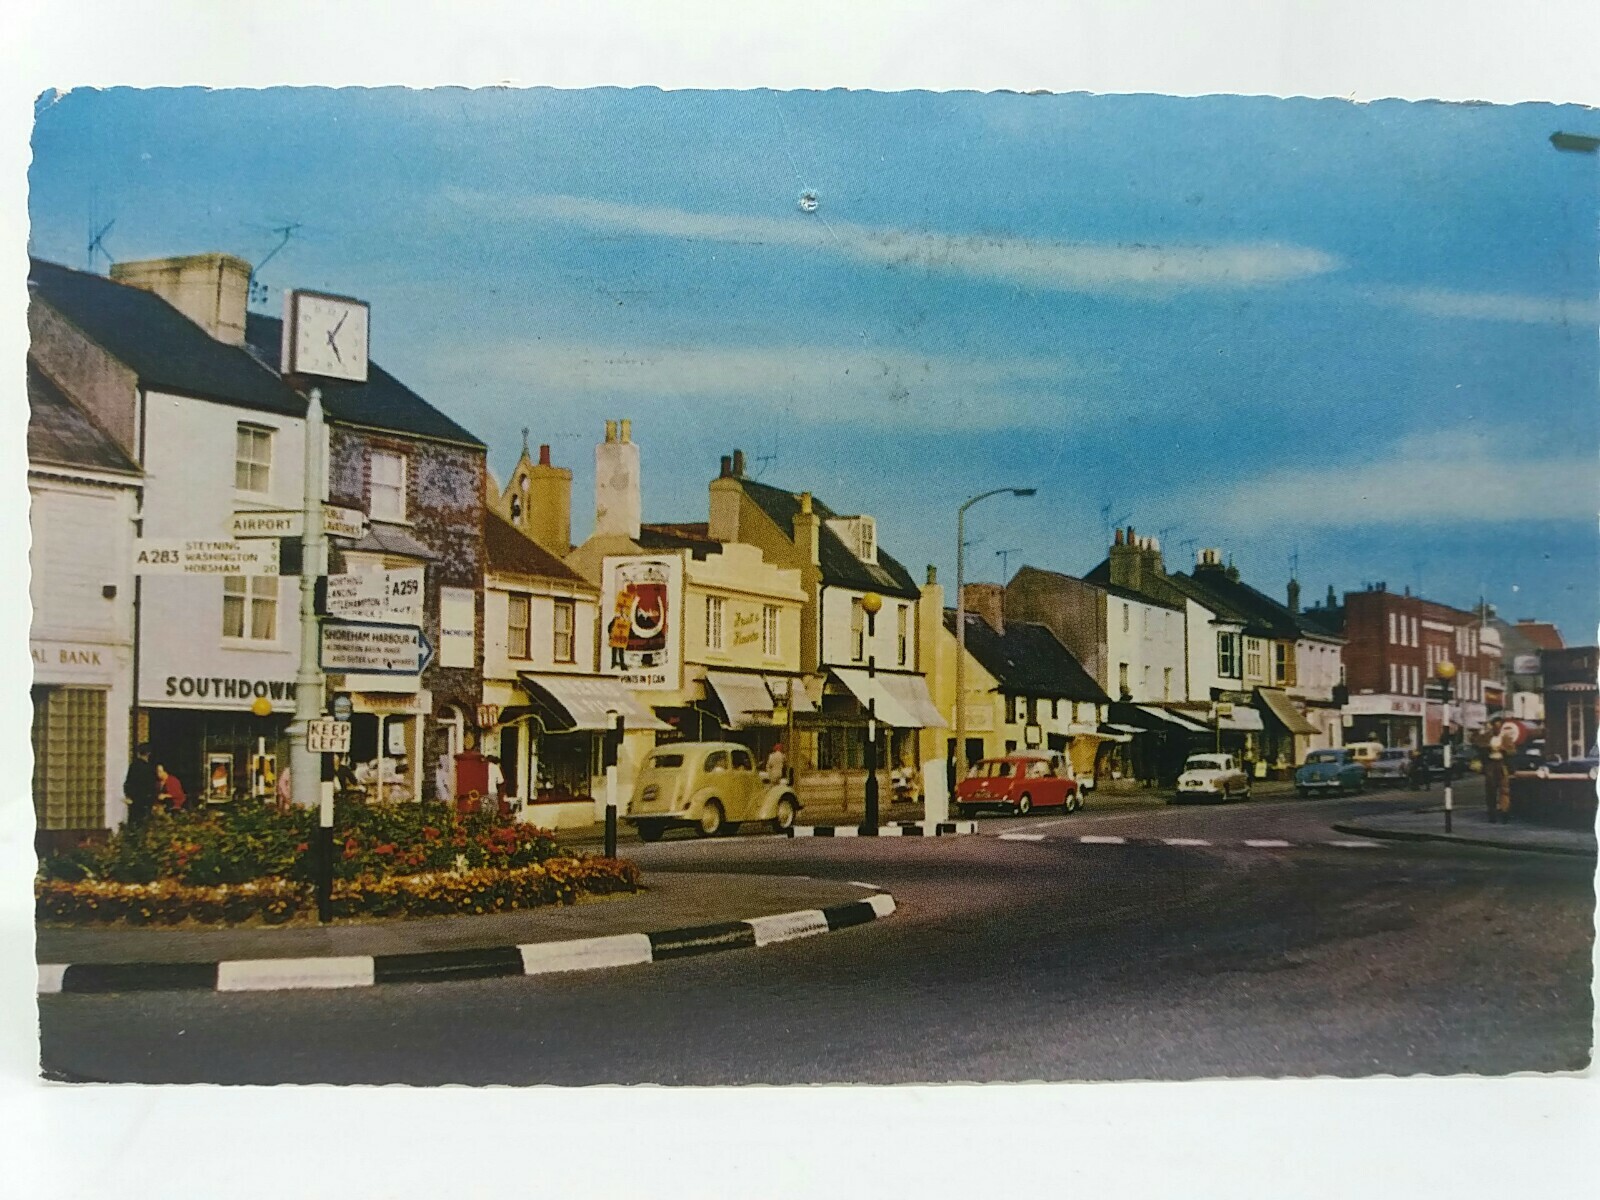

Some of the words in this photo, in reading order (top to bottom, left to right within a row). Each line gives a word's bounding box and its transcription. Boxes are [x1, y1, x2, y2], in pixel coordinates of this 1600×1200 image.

[233, 518, 292, 531] AIRPORT
[185, 541, 241, 551] STEYNING
[137, 549, 180, 564] A283
[185, 553, 259, 563] WASHINGTON
[184, 563, 241, 573] HORSHAM
[392, 579, 419, 596] A259
[324, 628, 371, 641] SHOREHAM
[372, 632, 410, 645] HARBOUR
[60, 650, 102, 666] BANK
[311, 724, 349, 736] KEEP
[312, 736, 347, 750] LEFT
